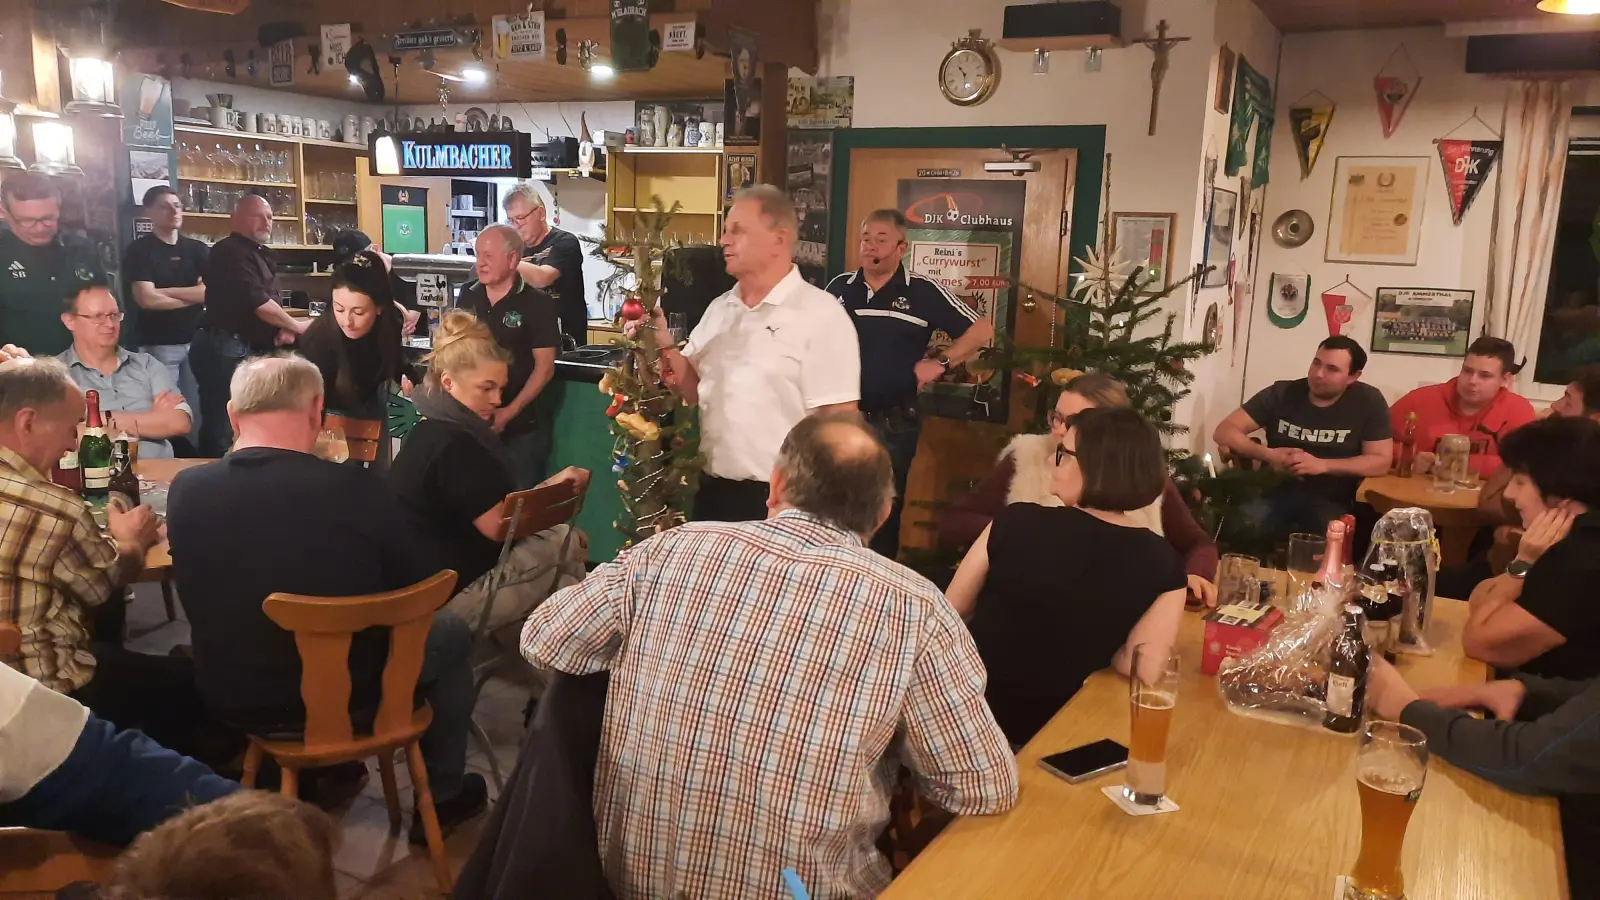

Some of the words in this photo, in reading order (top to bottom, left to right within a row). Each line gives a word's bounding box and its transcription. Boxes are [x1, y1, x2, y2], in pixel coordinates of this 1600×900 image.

[402, 140, 513, 169] KULMBACHER
[924, 214, 944, 224] DJK
[960, 215, 1013, 226] Clubhaus
[1278, 419, 1352, 443] FENDT
